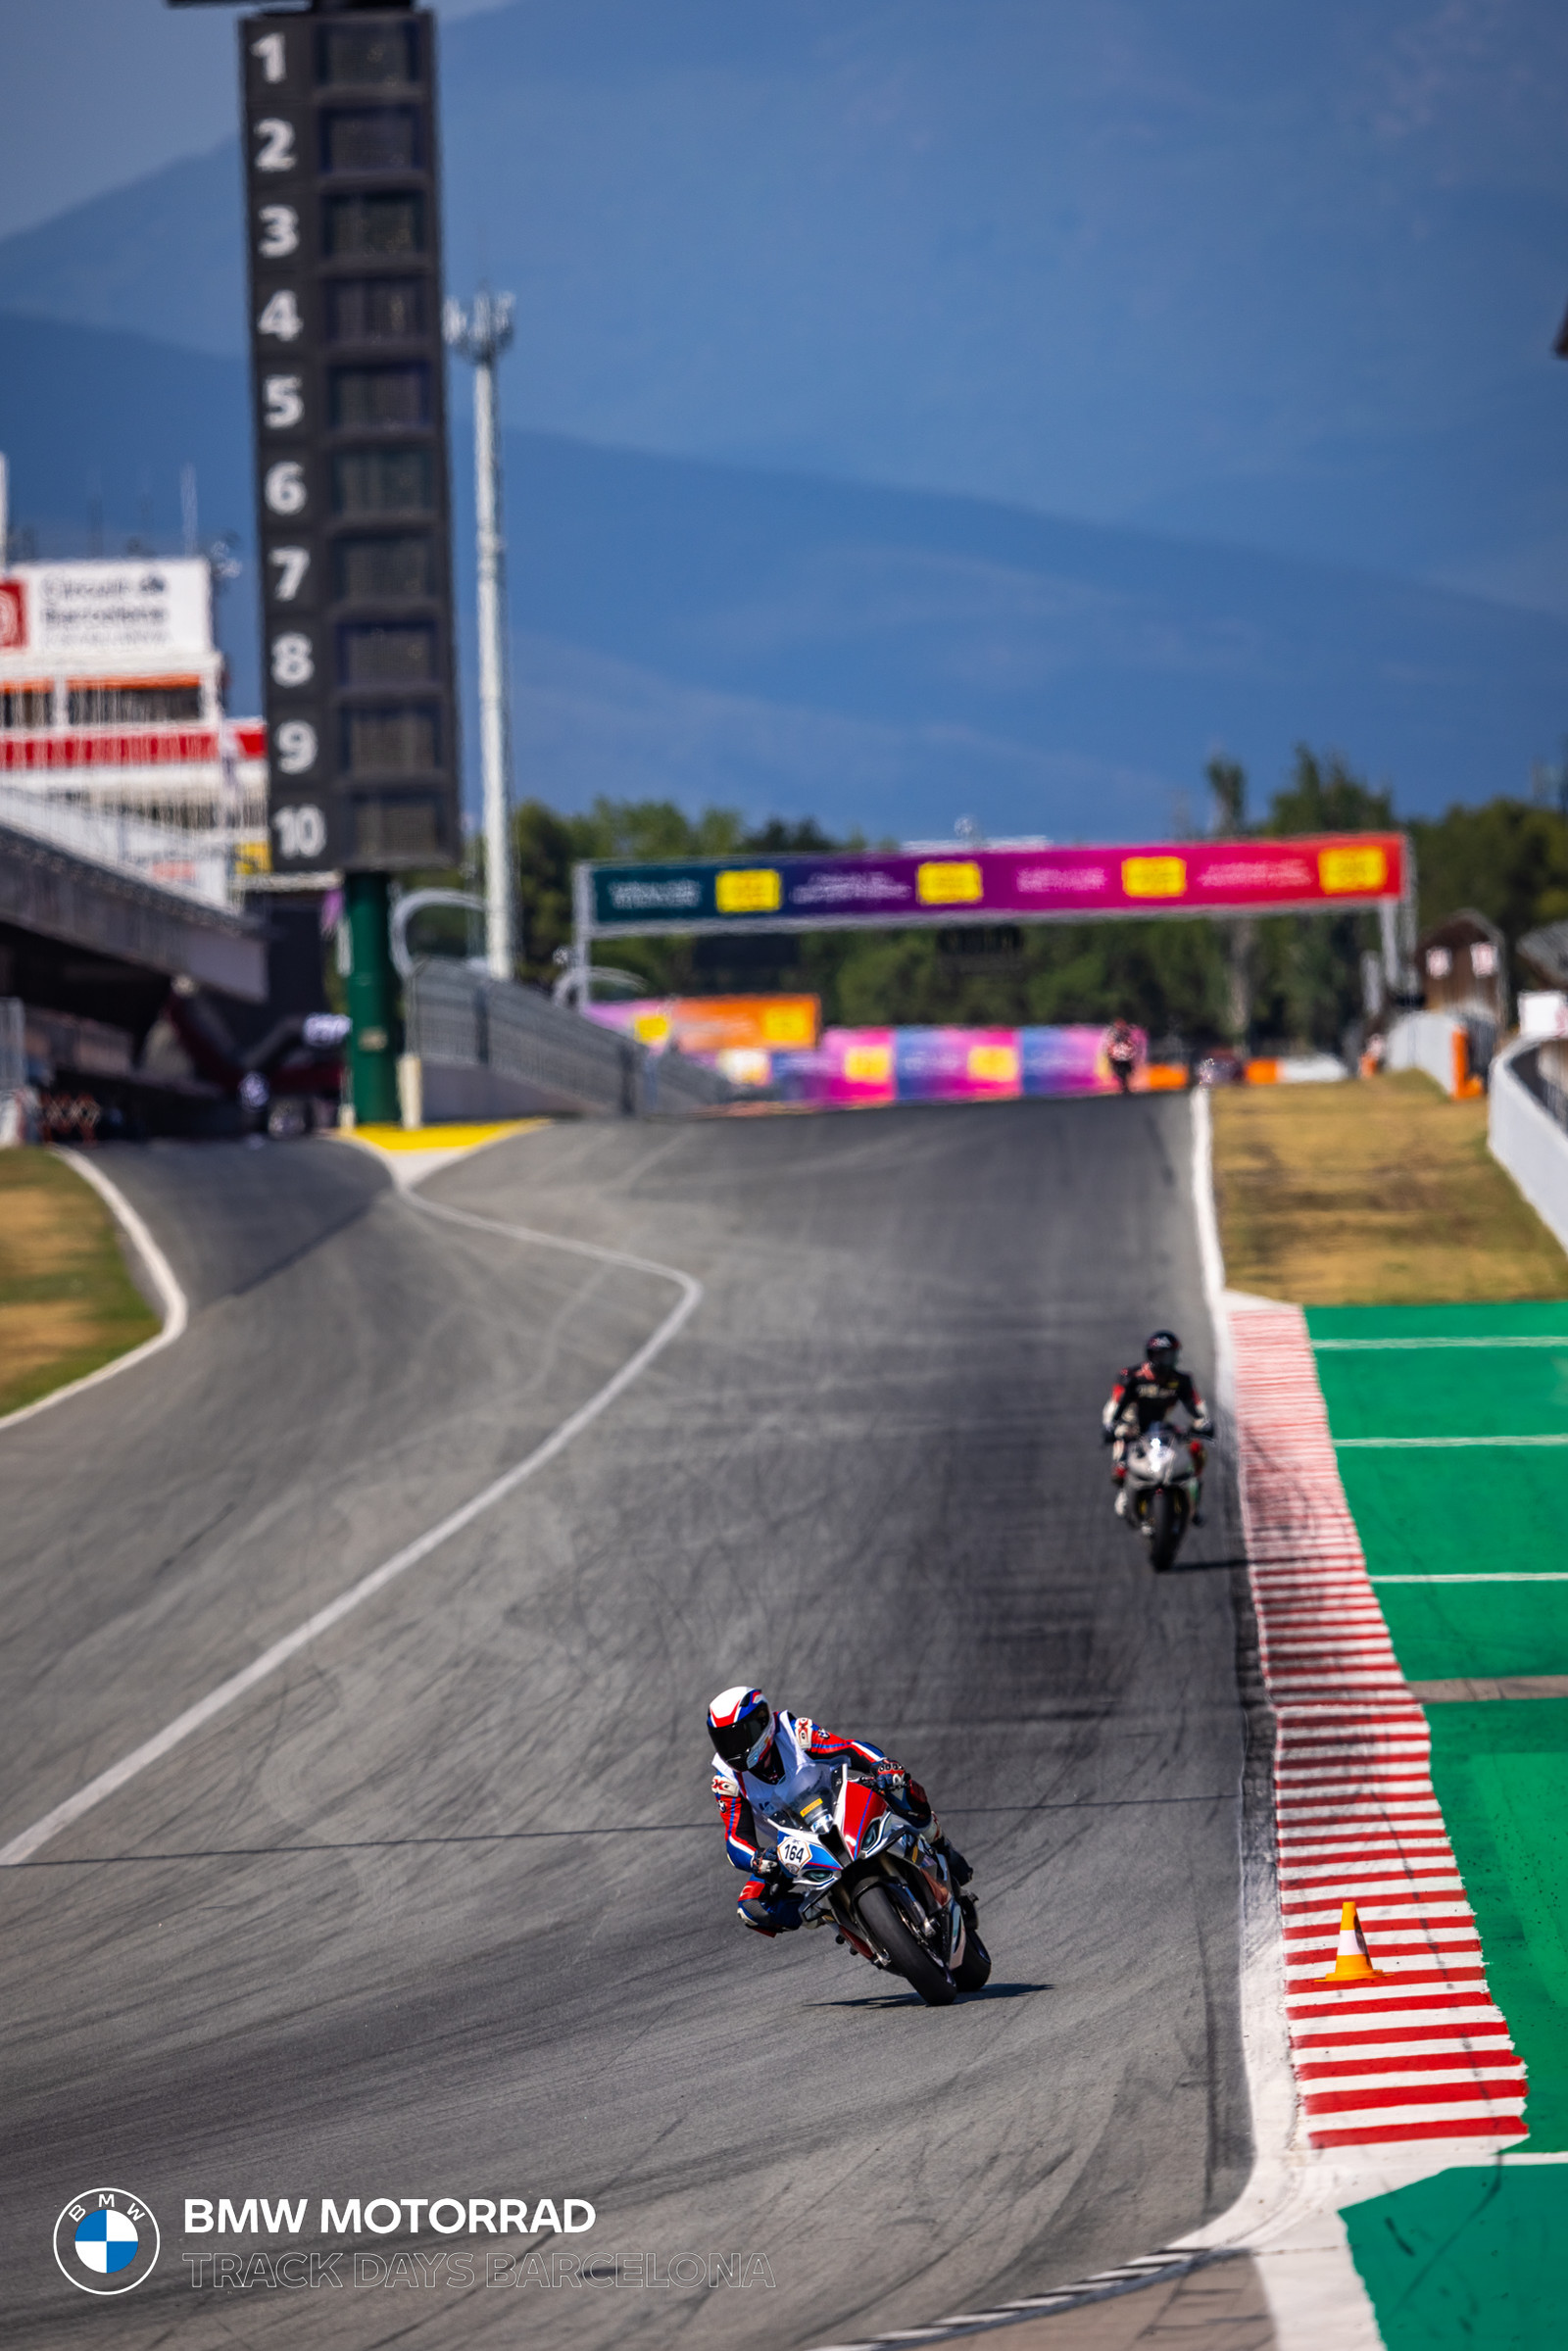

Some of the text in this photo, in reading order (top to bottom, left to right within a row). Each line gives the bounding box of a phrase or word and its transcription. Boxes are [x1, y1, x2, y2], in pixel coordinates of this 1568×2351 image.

[251, 34, 284, 81] 1
[257, 120, 296, 170] 2
[261, 207, 298, 256] 3
[258, 291, 302, 339] 4
[264, 376, 304, 427] 5
[266, 463, 306, 514] 6
[270, 549, 310, 600] 7
[272, 634, 314, 685] 8
[277, 721, 318, 773] 9
[274, 807, 326, 857] 10
[784, 1843, 805, 1863] 164
